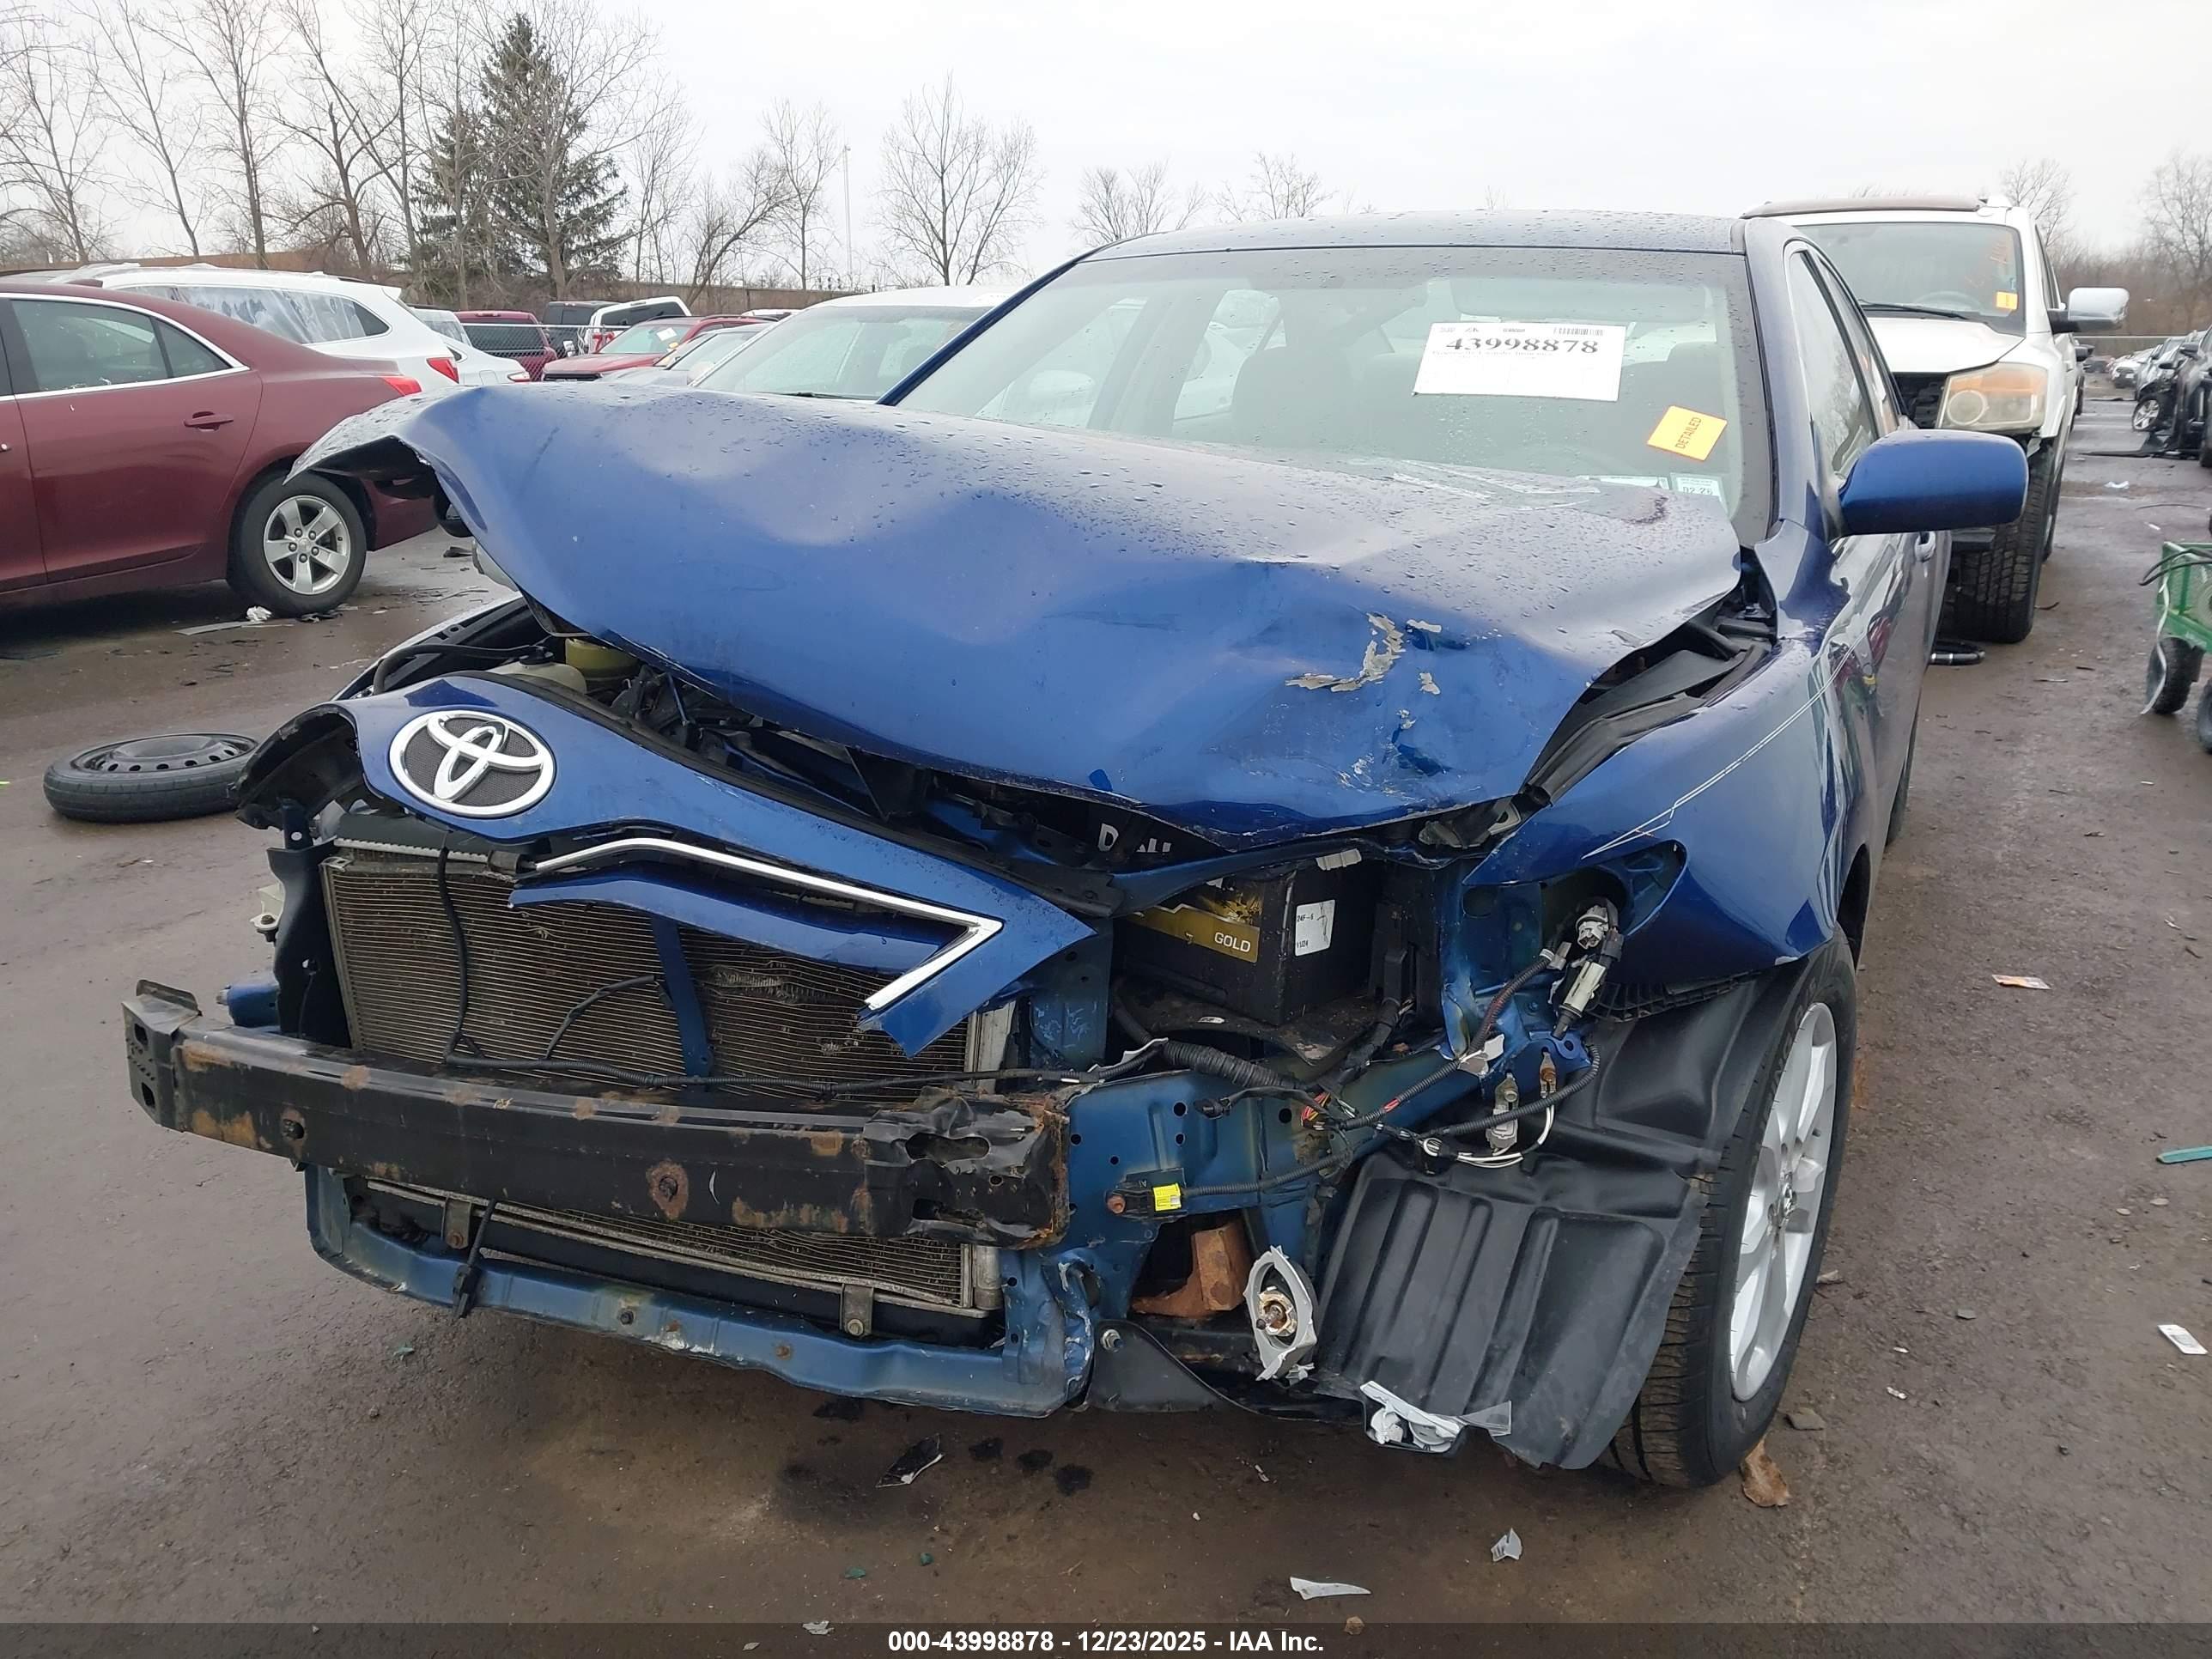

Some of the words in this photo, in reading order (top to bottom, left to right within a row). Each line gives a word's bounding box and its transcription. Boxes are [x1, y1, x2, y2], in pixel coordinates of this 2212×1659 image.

[1446, 337, 1599, 354] 43998878
[1674, 416, 1702, 449] DETAILED
[1214, 932, 1252, 953] GOLD
